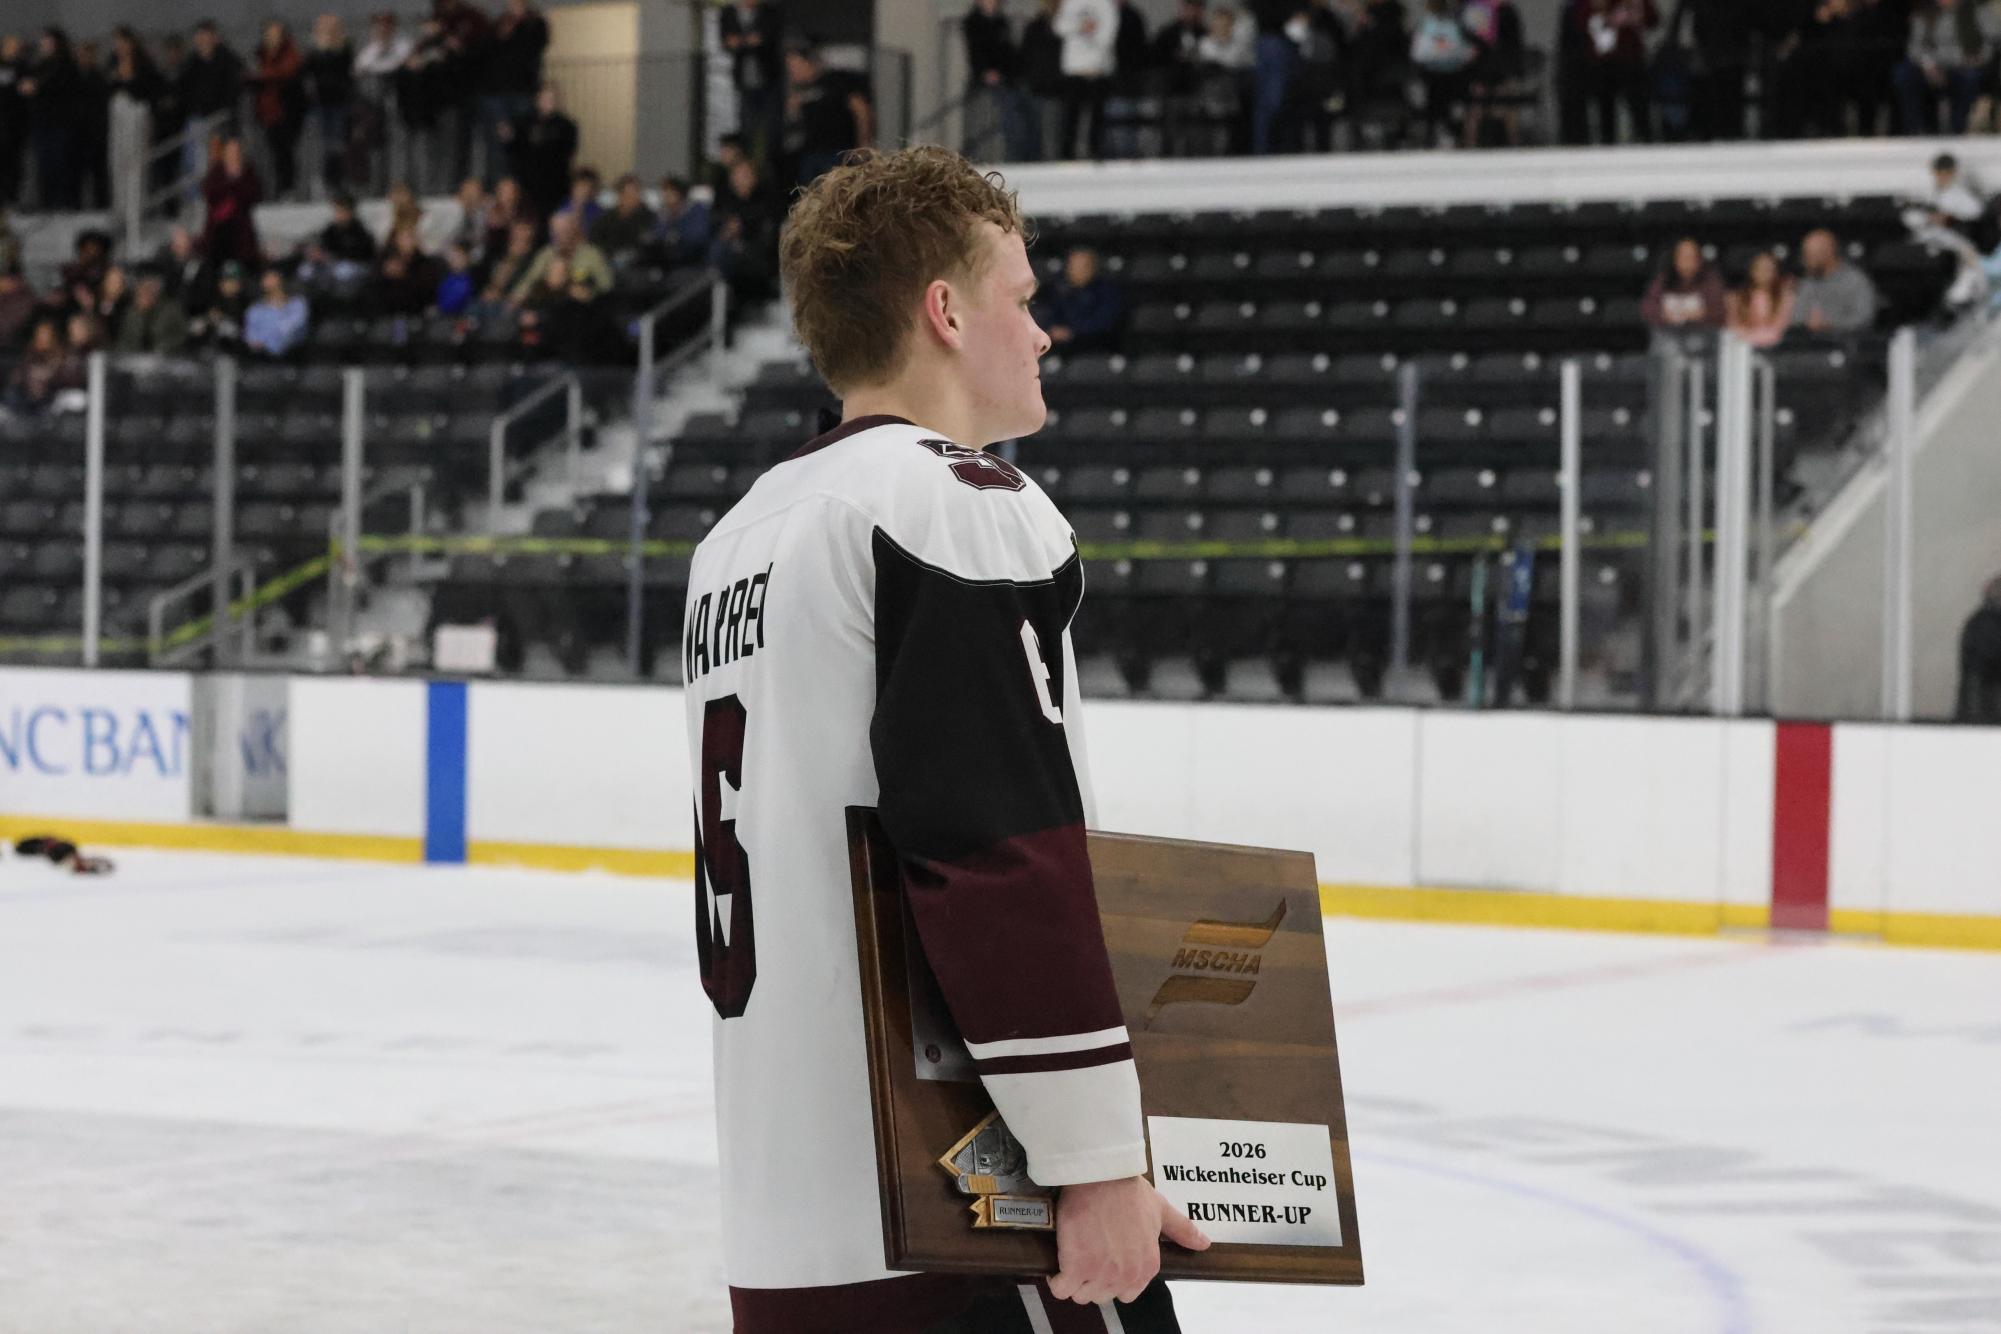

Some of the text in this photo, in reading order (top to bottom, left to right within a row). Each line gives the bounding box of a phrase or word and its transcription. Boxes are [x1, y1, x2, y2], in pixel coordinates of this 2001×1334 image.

[1171, 948, 1262, 975] MSCHA
[1219, 1141, 1267, 1159] 2026
[1162, 1165, 1327, 1191] Wickenheiser Cup
[999, 1206, 1044, 1216] RUNNER-UP
[1187, 1202, 1312, 1225] RUNNER-UP
